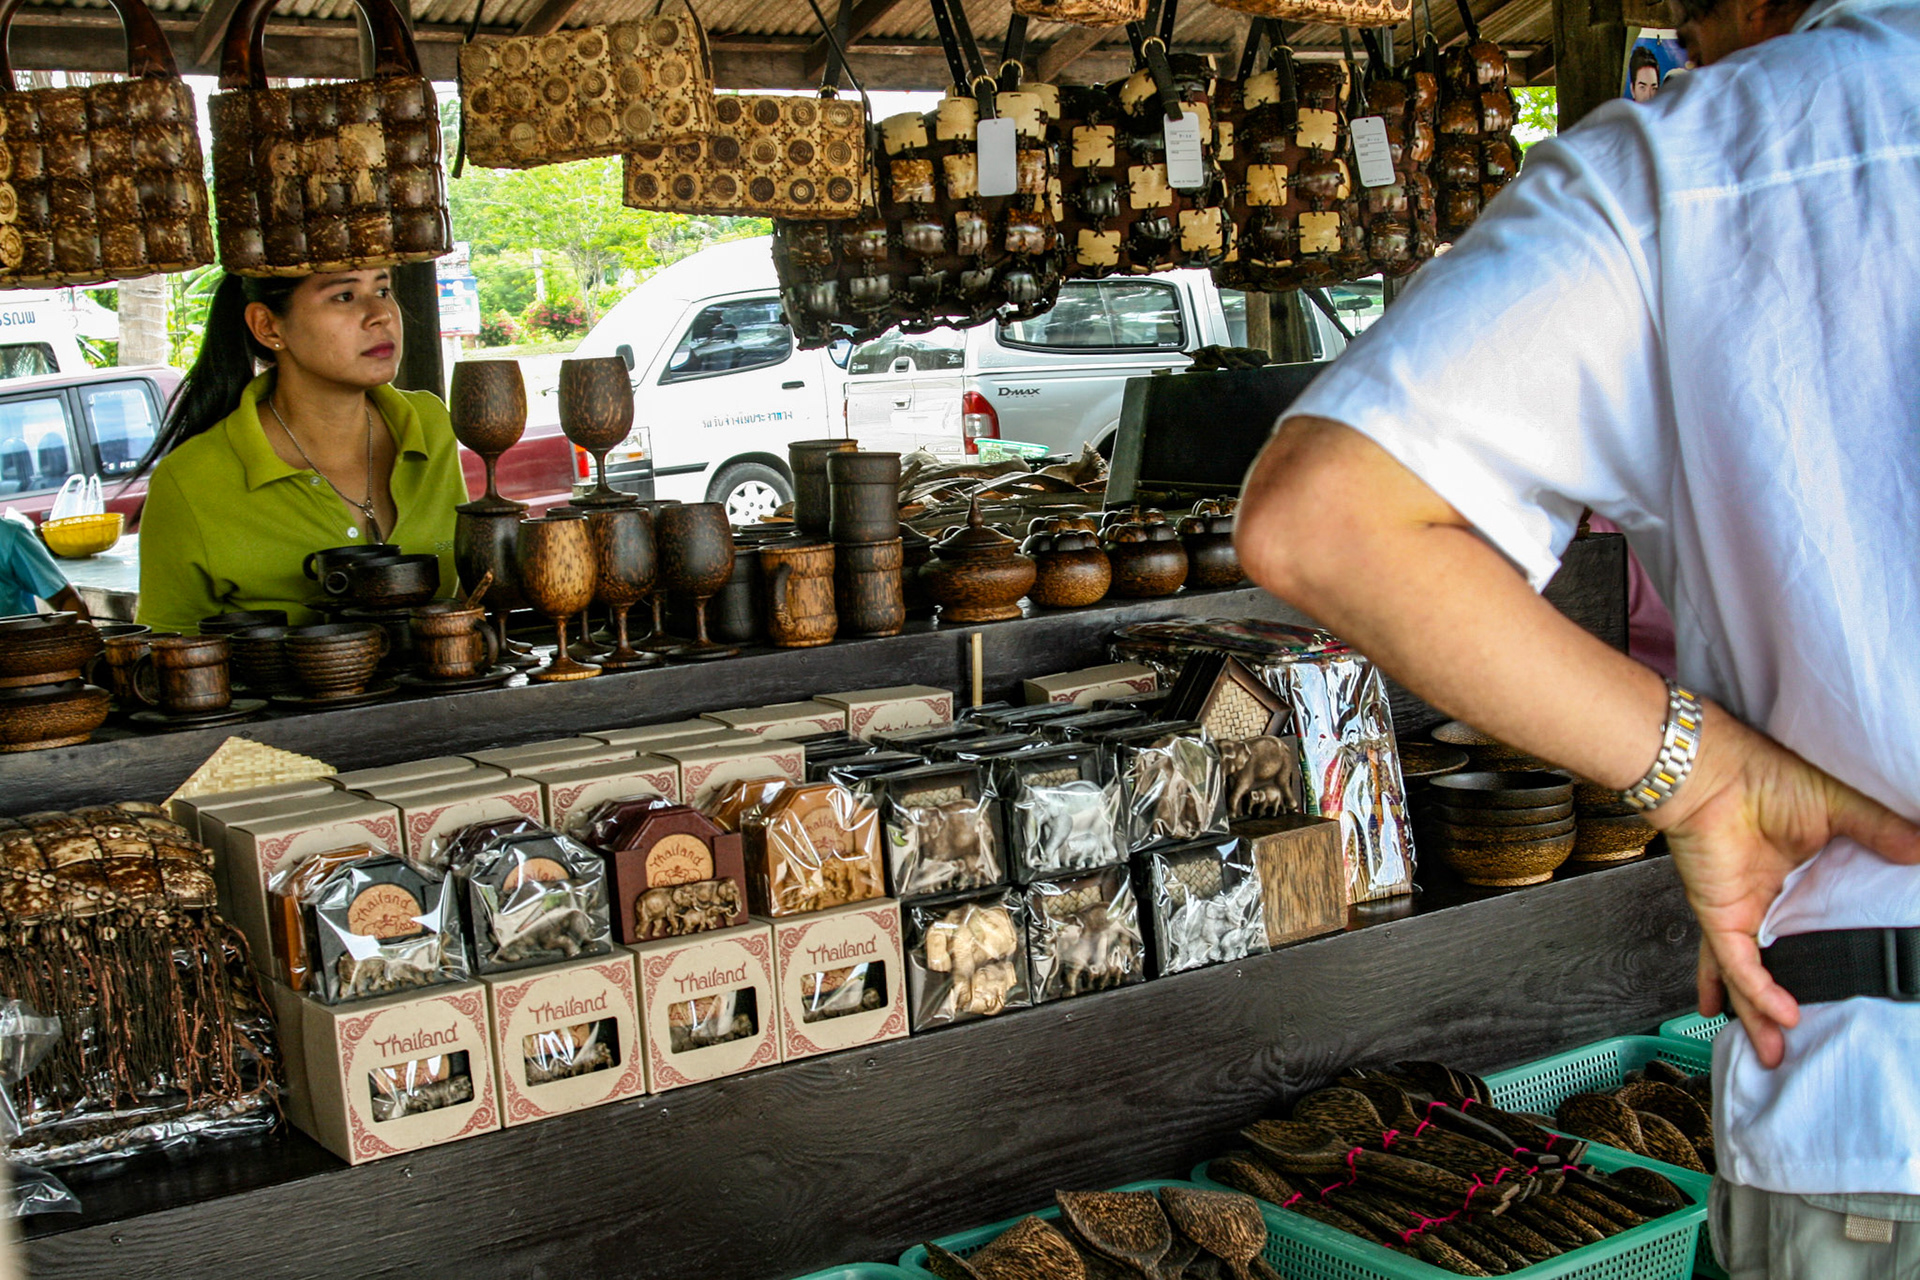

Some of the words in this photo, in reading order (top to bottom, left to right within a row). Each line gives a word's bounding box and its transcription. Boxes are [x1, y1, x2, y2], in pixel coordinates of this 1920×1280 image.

[649, 843, 704, 868] Thailand
[353, 891, 413, 923] Thailand
[806, 933, 877, 965] Thailand
[673, 961, 747, 994] Thailand
[527, 988, 608, 1025] Thailand
[373, 1020, 459, 1058] Thailand
